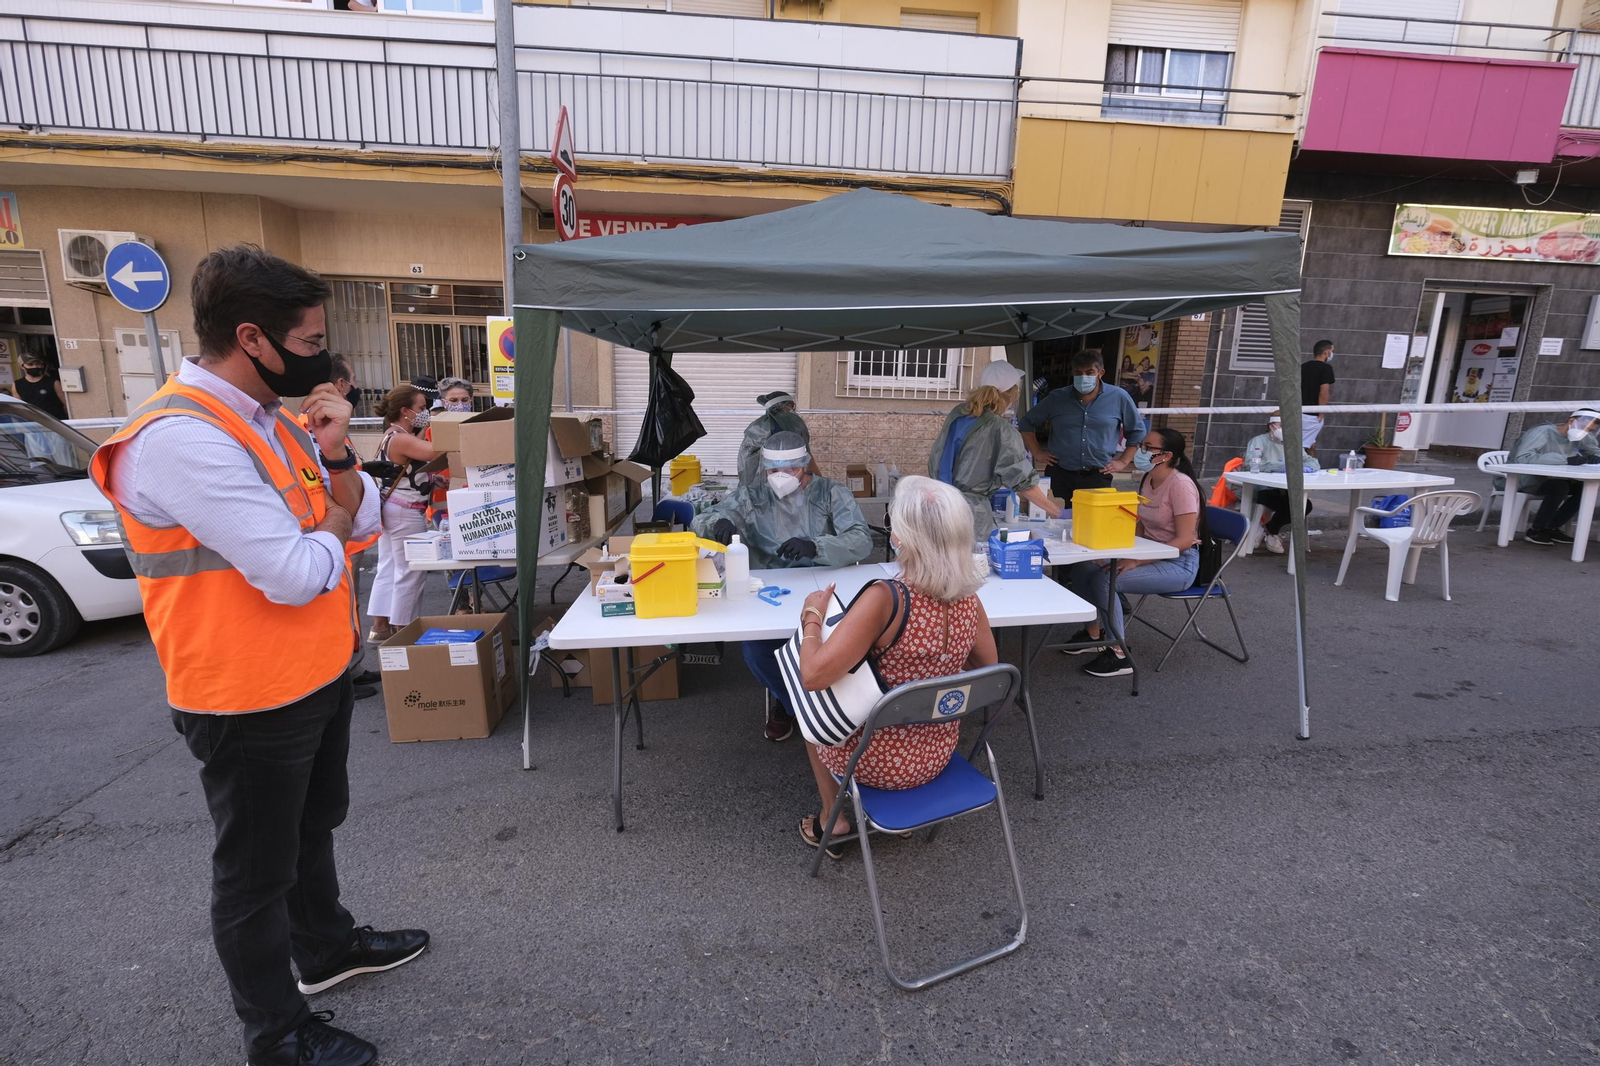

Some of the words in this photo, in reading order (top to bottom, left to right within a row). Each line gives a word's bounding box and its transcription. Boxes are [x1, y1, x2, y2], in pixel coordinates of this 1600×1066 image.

[562, 189, 575, 231] 30
[578, 219, 592, 237] E
[1457, 210, 1498, 235] SUPER
[1499, 212, 1557, 237] MARKET
[1469, 237, 1532, 258] مجزرة
[412, 266, 422, 274] 63
[66, 341, 76, 349] 61
[459, 509, 516, 532] HUMANITARI
[472, 507, 501, 521] AYUDA
[462, 521, 513, 543] HUMANITARIAN
[418, 700, 438, 709] mole
